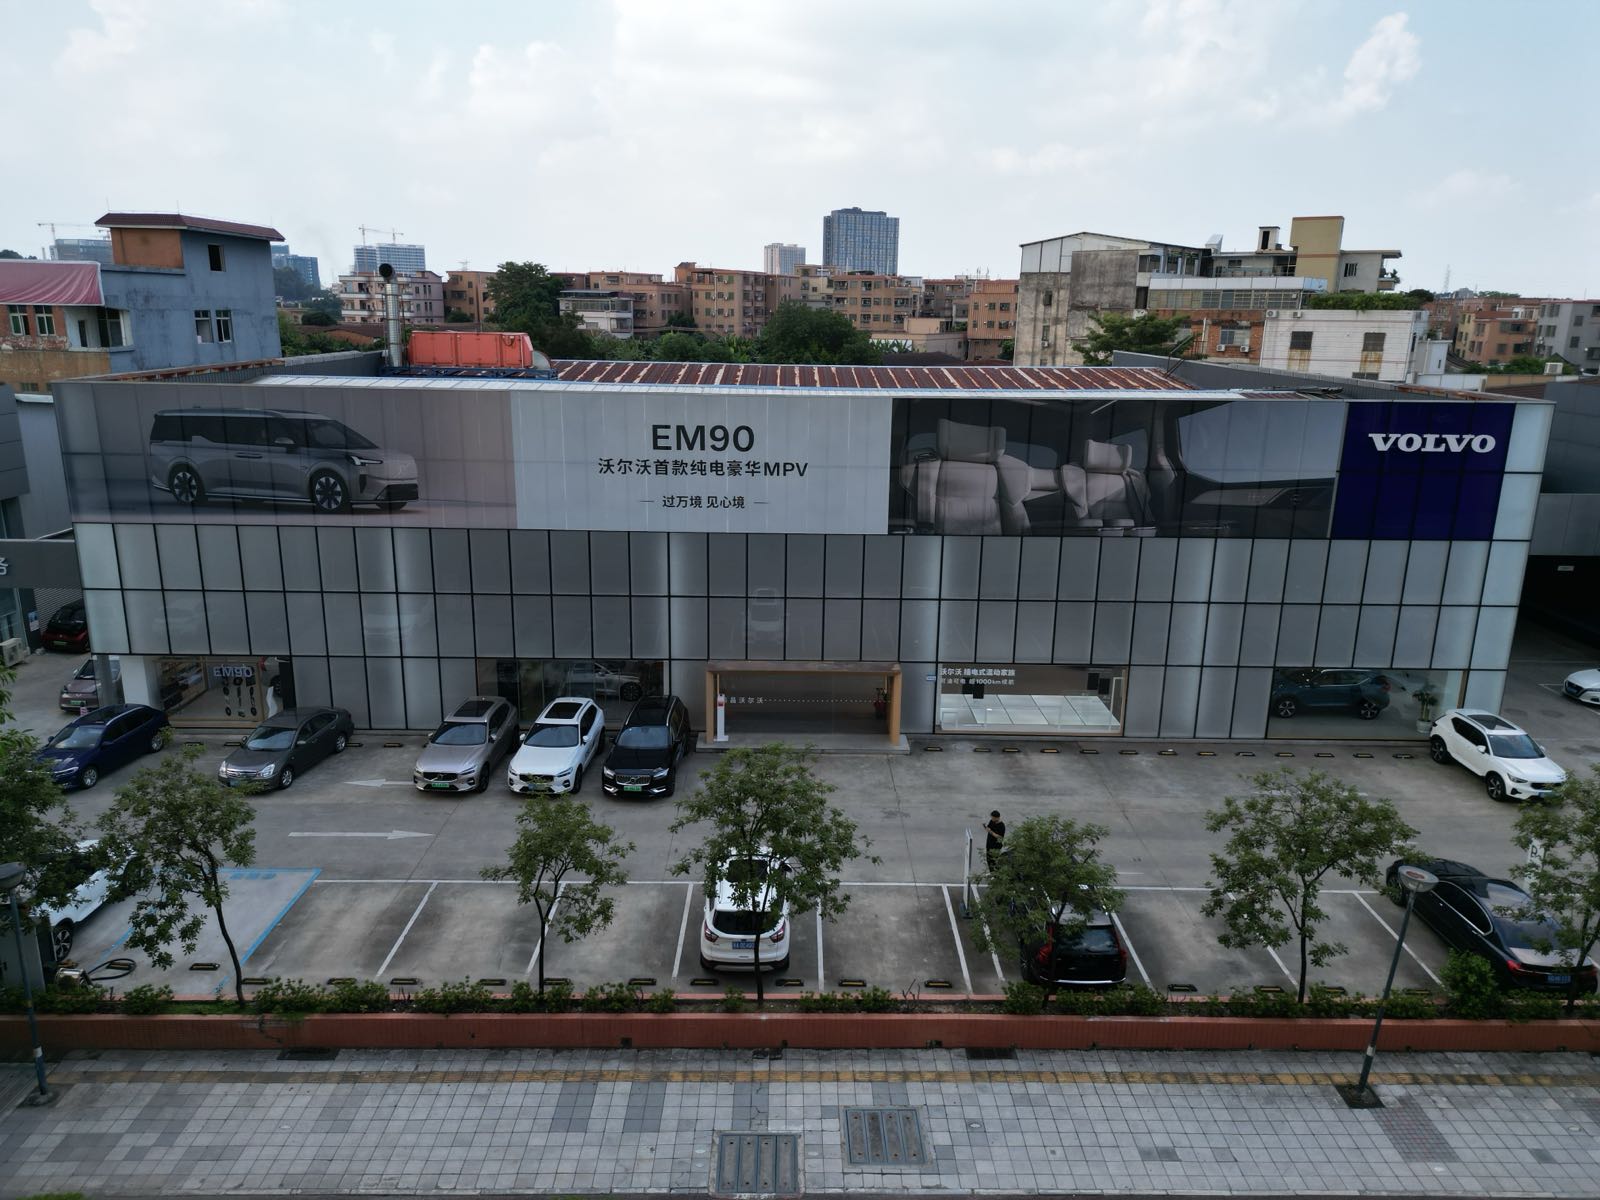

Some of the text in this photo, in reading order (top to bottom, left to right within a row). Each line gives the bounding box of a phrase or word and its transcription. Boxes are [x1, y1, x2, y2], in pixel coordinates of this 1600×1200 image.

[652, 424, 755, 452] EM90
[1368, 433, 1496, 453] VOLVO
[598, 458, 808, 477] 沃尔沃首款纯电豪华MPV
[662, 495, 745, 509] 过万境 见心境
[213, 666, 252, 677] EM90
